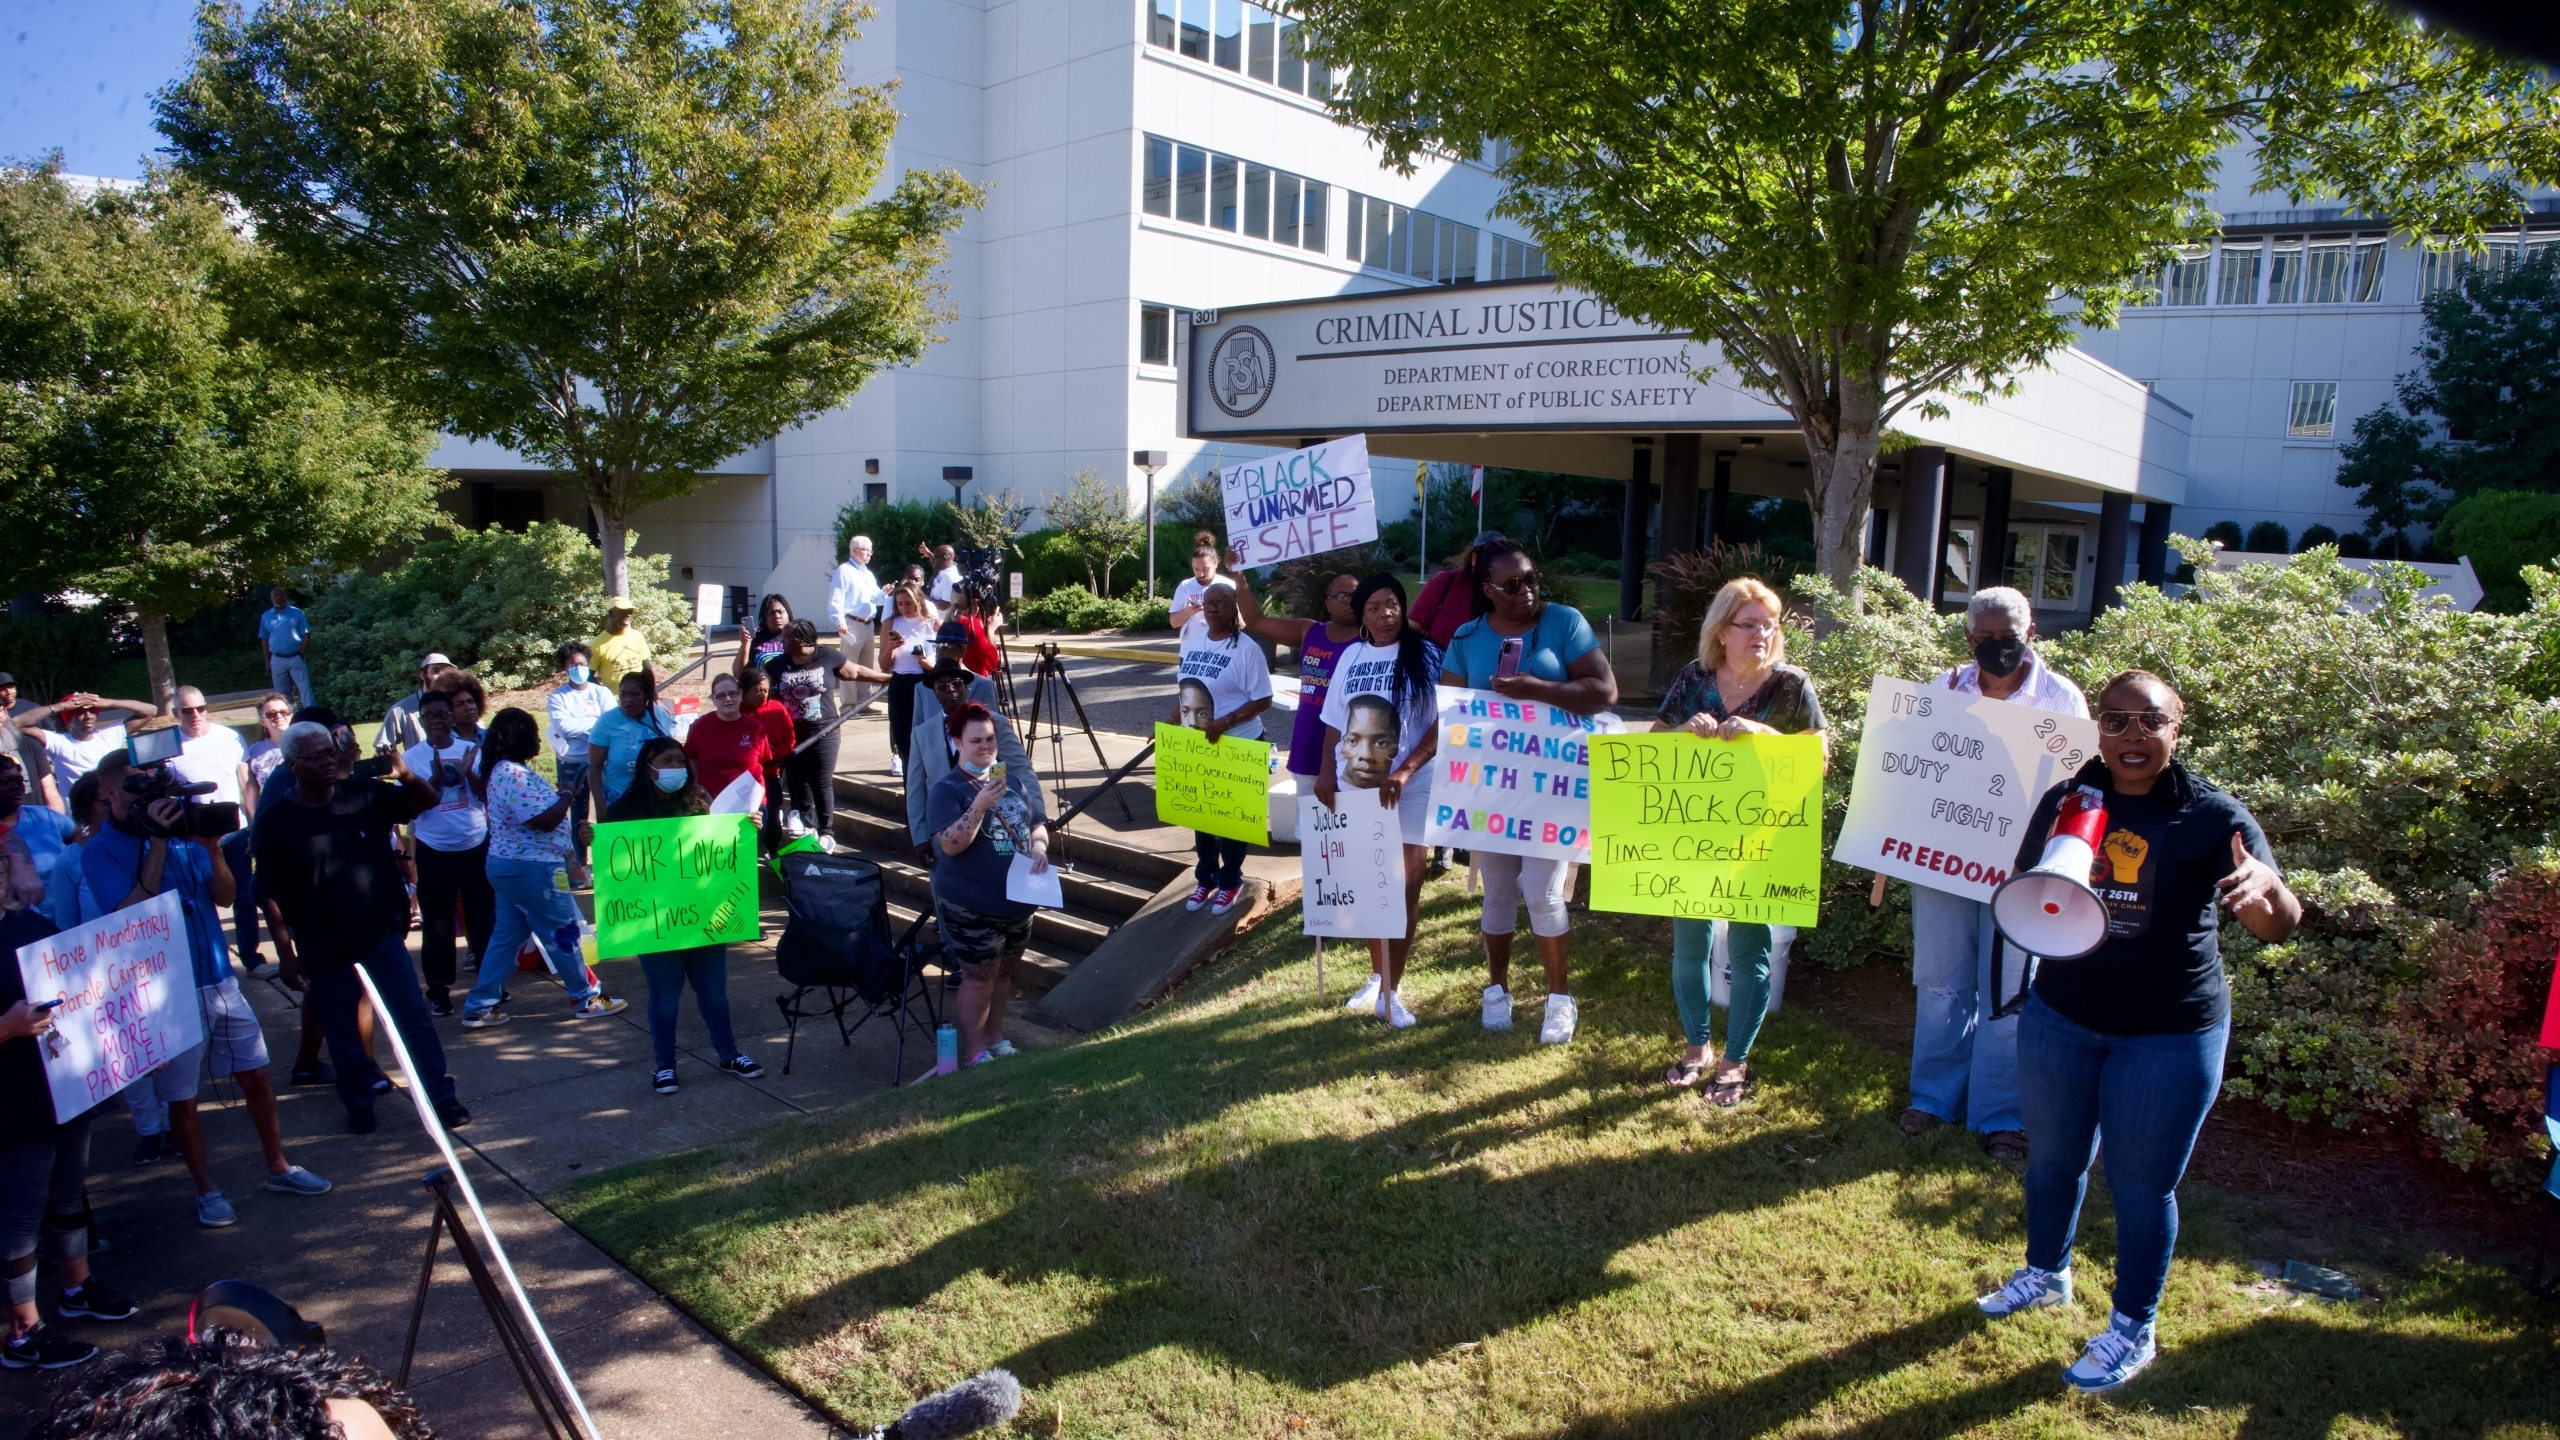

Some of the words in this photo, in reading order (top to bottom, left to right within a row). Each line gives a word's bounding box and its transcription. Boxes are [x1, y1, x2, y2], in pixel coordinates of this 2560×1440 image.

[1195, 310, 1216, 324] 301
[1315, 308, 1470, 345] CRIMINAL
[1478, 298, 1620, 335] JUSTICE
[1222, 351, 1266, 391] RSA
[1383, 363, 1509, 385] DEPARTMENT
[1514, 362, 1534, 380] of
[1537, 355, 1692, 379] CORRECTIONS
[1377, 393, 1501, 413] DEPARTMENT
[1506, 391, 1526, 410] of
[1529, 389, 1605, 408] PUBLIC
[1611, 387, 1698, 406] SAFETY
[1244, 448, 1331, 500] BLACK
[1248, 476, 1356, 527] UNARMED
[1257, 507, 1359, 563] SAFE
[1303, 655, 1321, 667] FOR
[1306, 646, 1334, 660] FIGHT
[1355, 661, 1373, 677] WAS
[1372, 660, 1391, 676] ONLY
[1359, 676, 1374, 692] DID
[1374, 676, 1384, 692] 15
[1455, 699, 1538, 723] THERE
[1549, 706, 1610, 735] MUST
[1892, 692, 1932, 717] ITS
[1161, 731, 1182, 752] We
[1185, 739, 1220, 758] Need
[1225, 745, 1267, 769] Justice!
[1450, 724, 1482, 748] BE
[1491, 729, 1589, 767] CHANGE
[1932, 732, 1985, 760] OUR
[1160, 755, 1193, 779] Stop
[1449, 760, 1518, 790] WITH
[1533, 772, 1588, 800] THE
[1882, 752, 1950, 783] DUTY
[1988, 775, 2005, 796] 2
[1171, 797, 1205, 814] Good
[1202, 801, 1233, 819] Time
[1312, 806, 1348, 832] Justice
[1637, 785, 1729, 825] BACK
[1735, 790, 1808, 828] Good
[1931, 798, 2012, 837] FIGHT
[1436, 805, 1533, 841] PAROLE
[1542, 822, 1592, 850] BOA
[1320, 834, 1330, 875] 4
[1881, 837, 2006, 887] FREEDOM
[1630, 872, 1687, 898] FOR
[1710, 876, 1752, 898] ALL
[2108, 889, 2139, 902] 26TH
[2120, 903, 2147, 911] CHAIN
[43, 944, 87, 979] Have
[57, 977, 106, 1019] Parole
[94, 981, 151, 1035] GRANT
[103, 1016, 152, 1065] MORE
